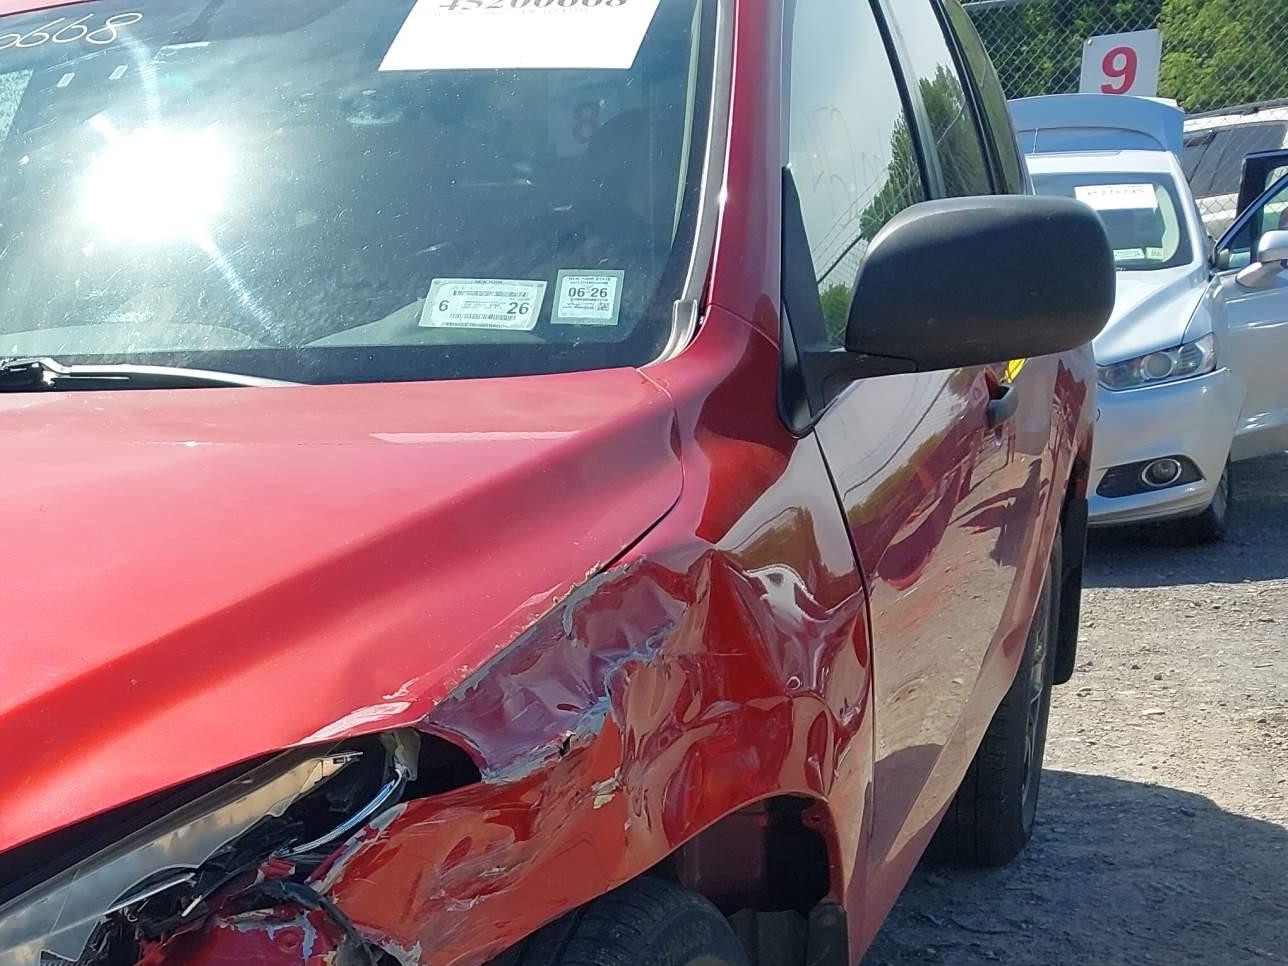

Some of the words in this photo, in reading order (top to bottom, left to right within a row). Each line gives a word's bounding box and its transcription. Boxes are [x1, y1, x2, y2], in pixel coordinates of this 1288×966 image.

[1100, 46, 1138, 96] 9
[438, 300, 450, 312] 6
[506, 301, 530, 315] 26
